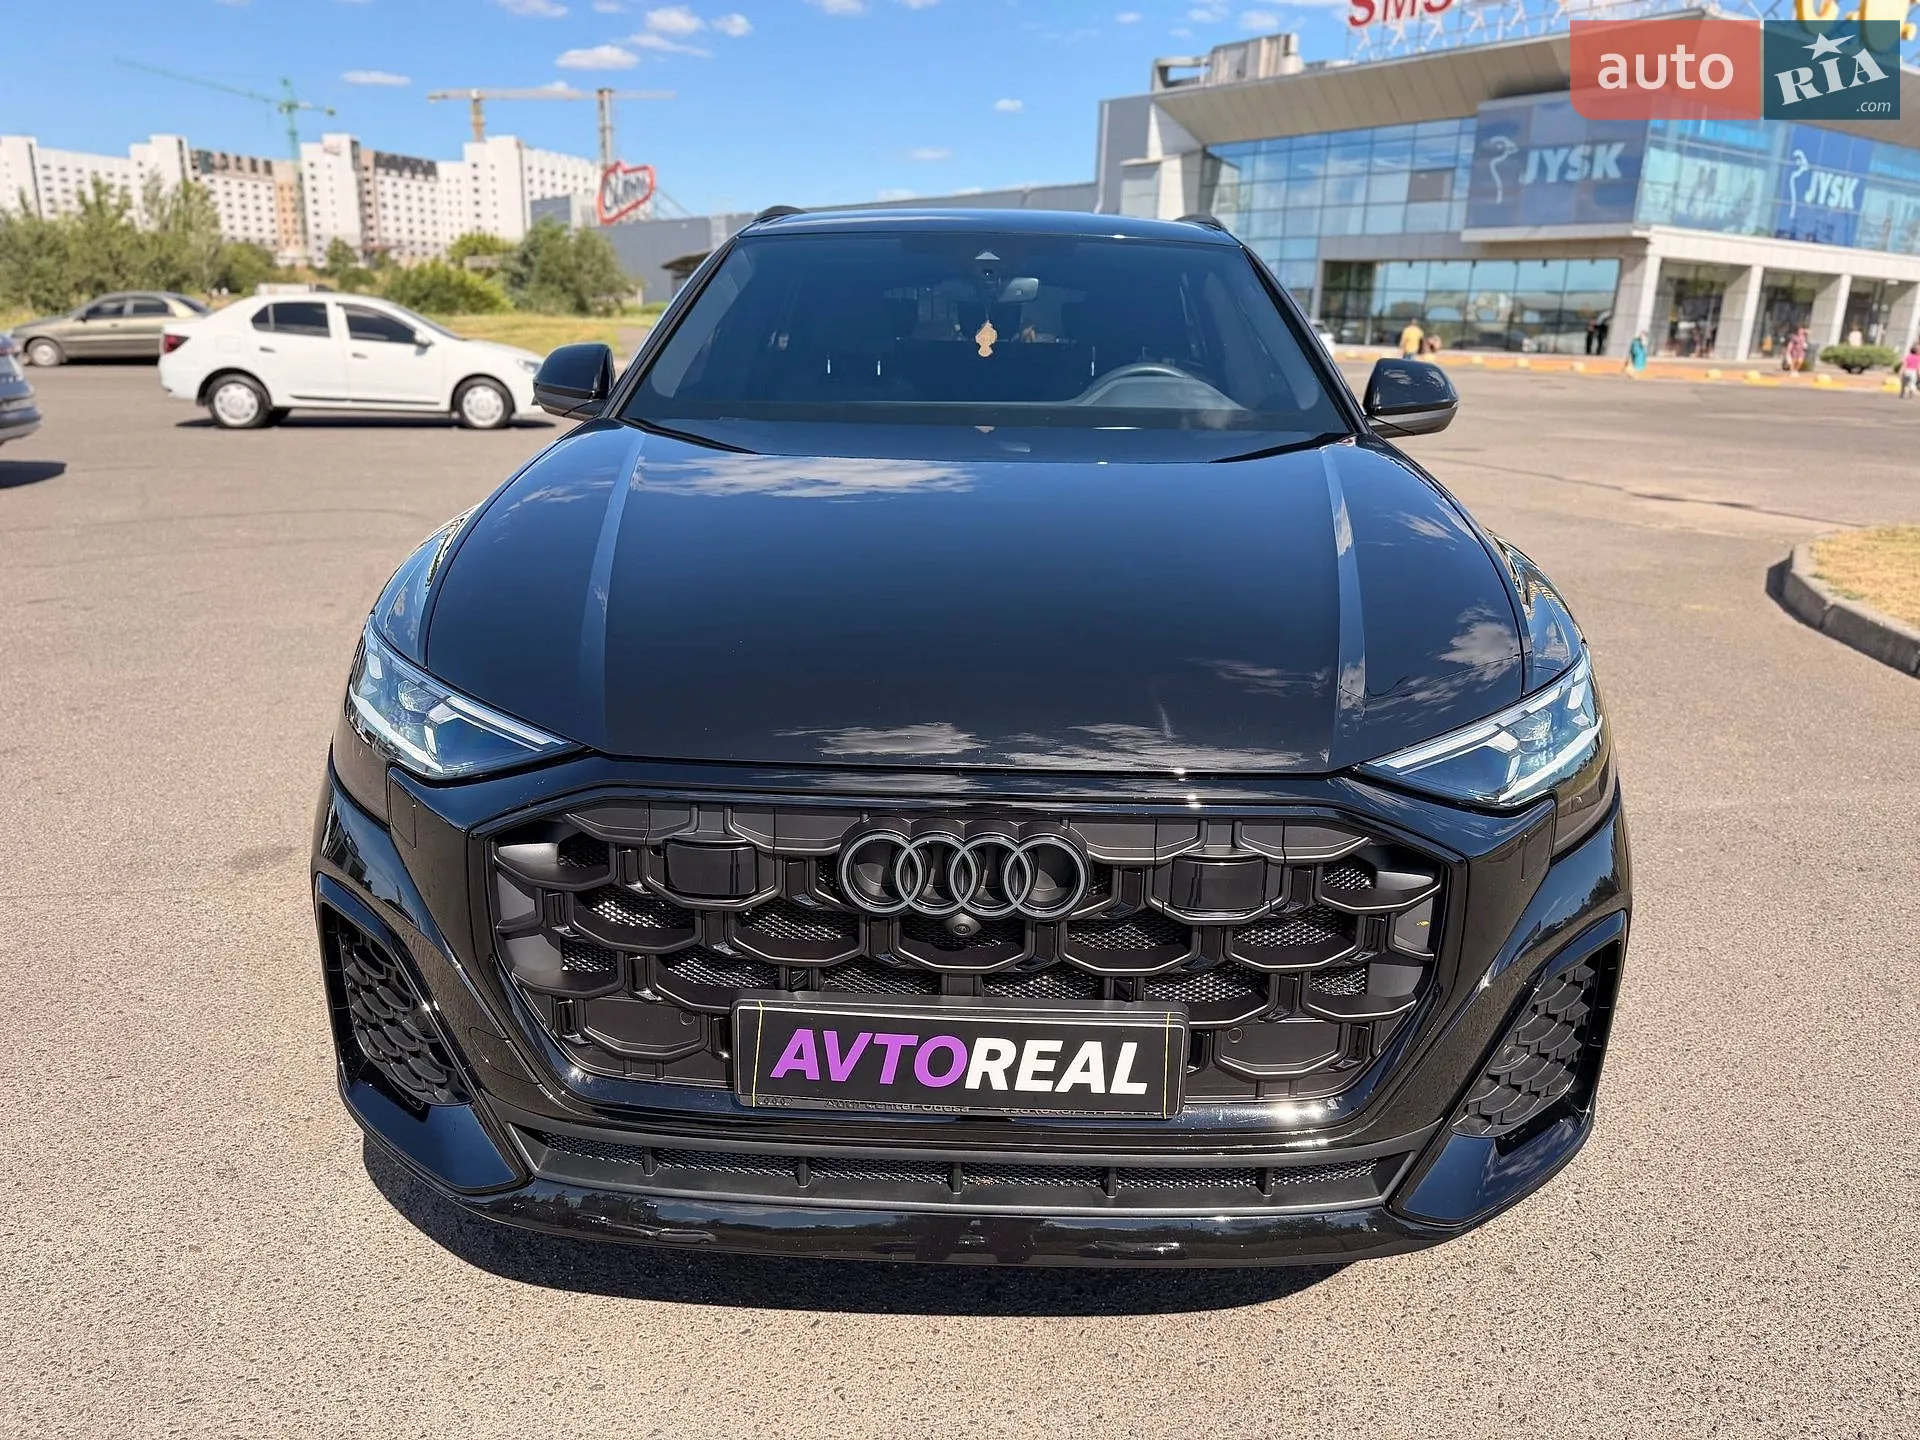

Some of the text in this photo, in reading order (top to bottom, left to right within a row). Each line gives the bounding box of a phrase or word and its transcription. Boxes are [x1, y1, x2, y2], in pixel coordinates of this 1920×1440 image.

[1519, 142, 1627, 185] JYSK
[1804, 170, 1860, 209] JYSK
[769, 1028, 1149, 1095] AVTOREAL
